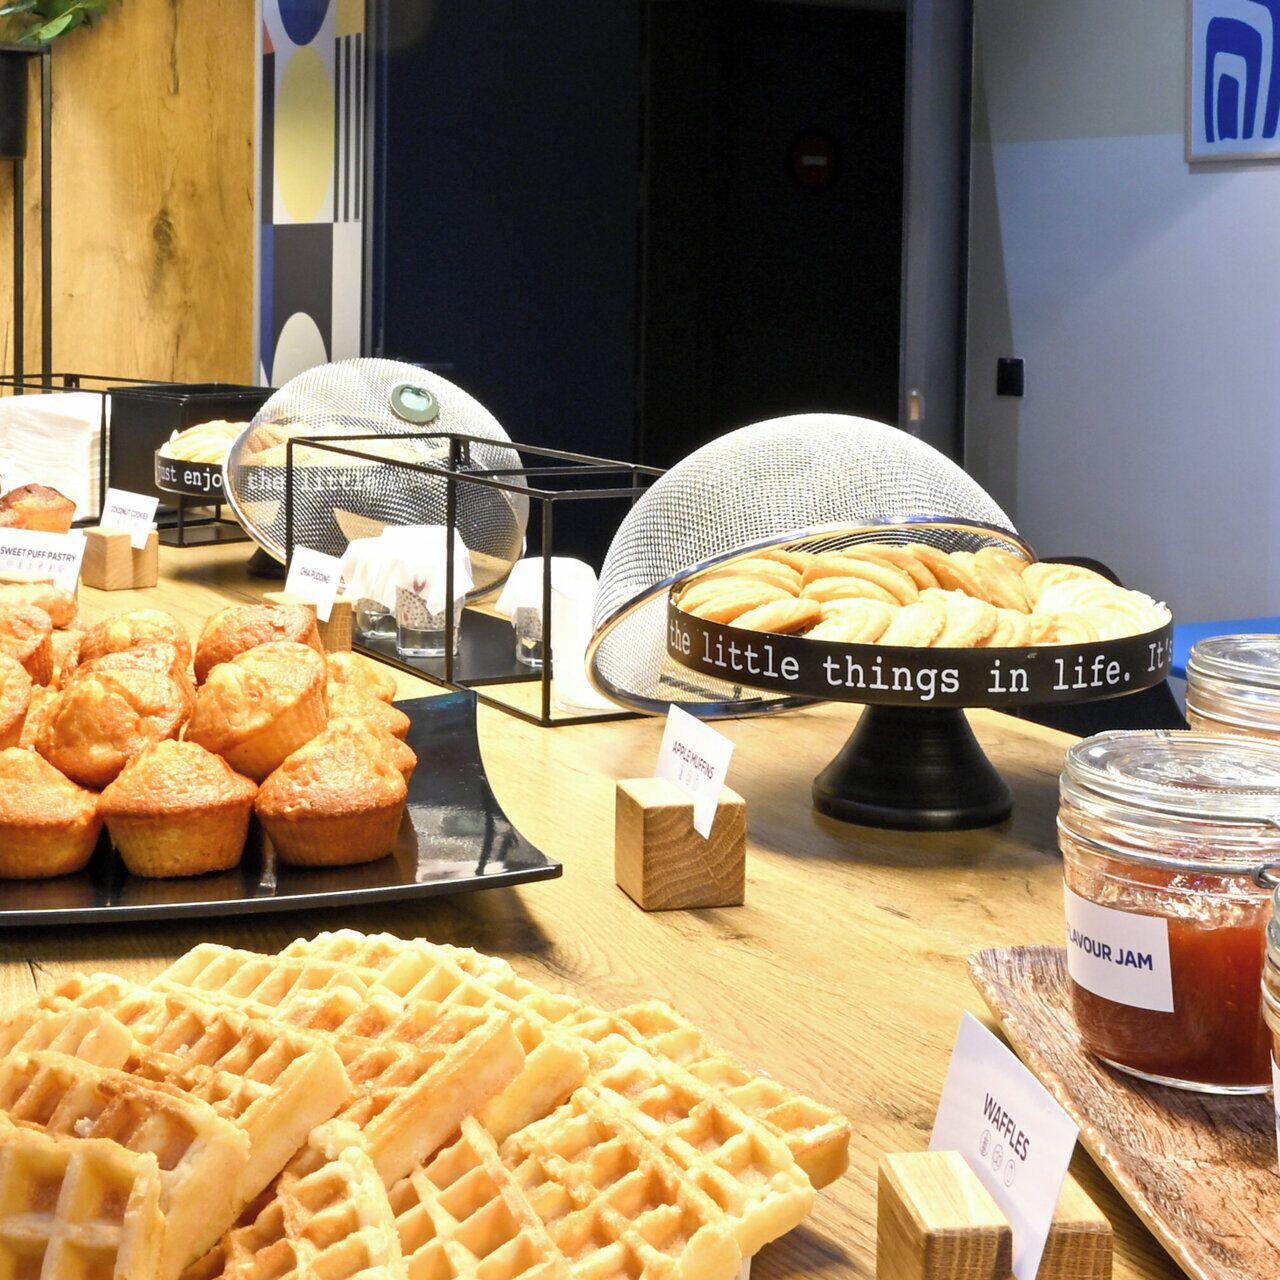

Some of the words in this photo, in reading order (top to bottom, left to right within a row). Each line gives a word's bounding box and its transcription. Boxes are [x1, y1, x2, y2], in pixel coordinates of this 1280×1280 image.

[183, 467, 223, 492] enjo
[0, 546, 27, 557] SWEET
[26, 549, 47, 559] PUFF
[47, 551, 78, 563] PASTRY
[669, 620, 691, 655] the
[702, 631, 800, 681] little
[823, 654, 960, 701] things
[987, 659, 1030, 693] in
[1052, 654, 1130, 690] life.
[672, 740, 692, 763] APPLE
[689, 751, 715, 780] MUFFINS
[1115, 948, 1153, 971] JAM
[983, 1092, 1031, 1162] WAFFLES
